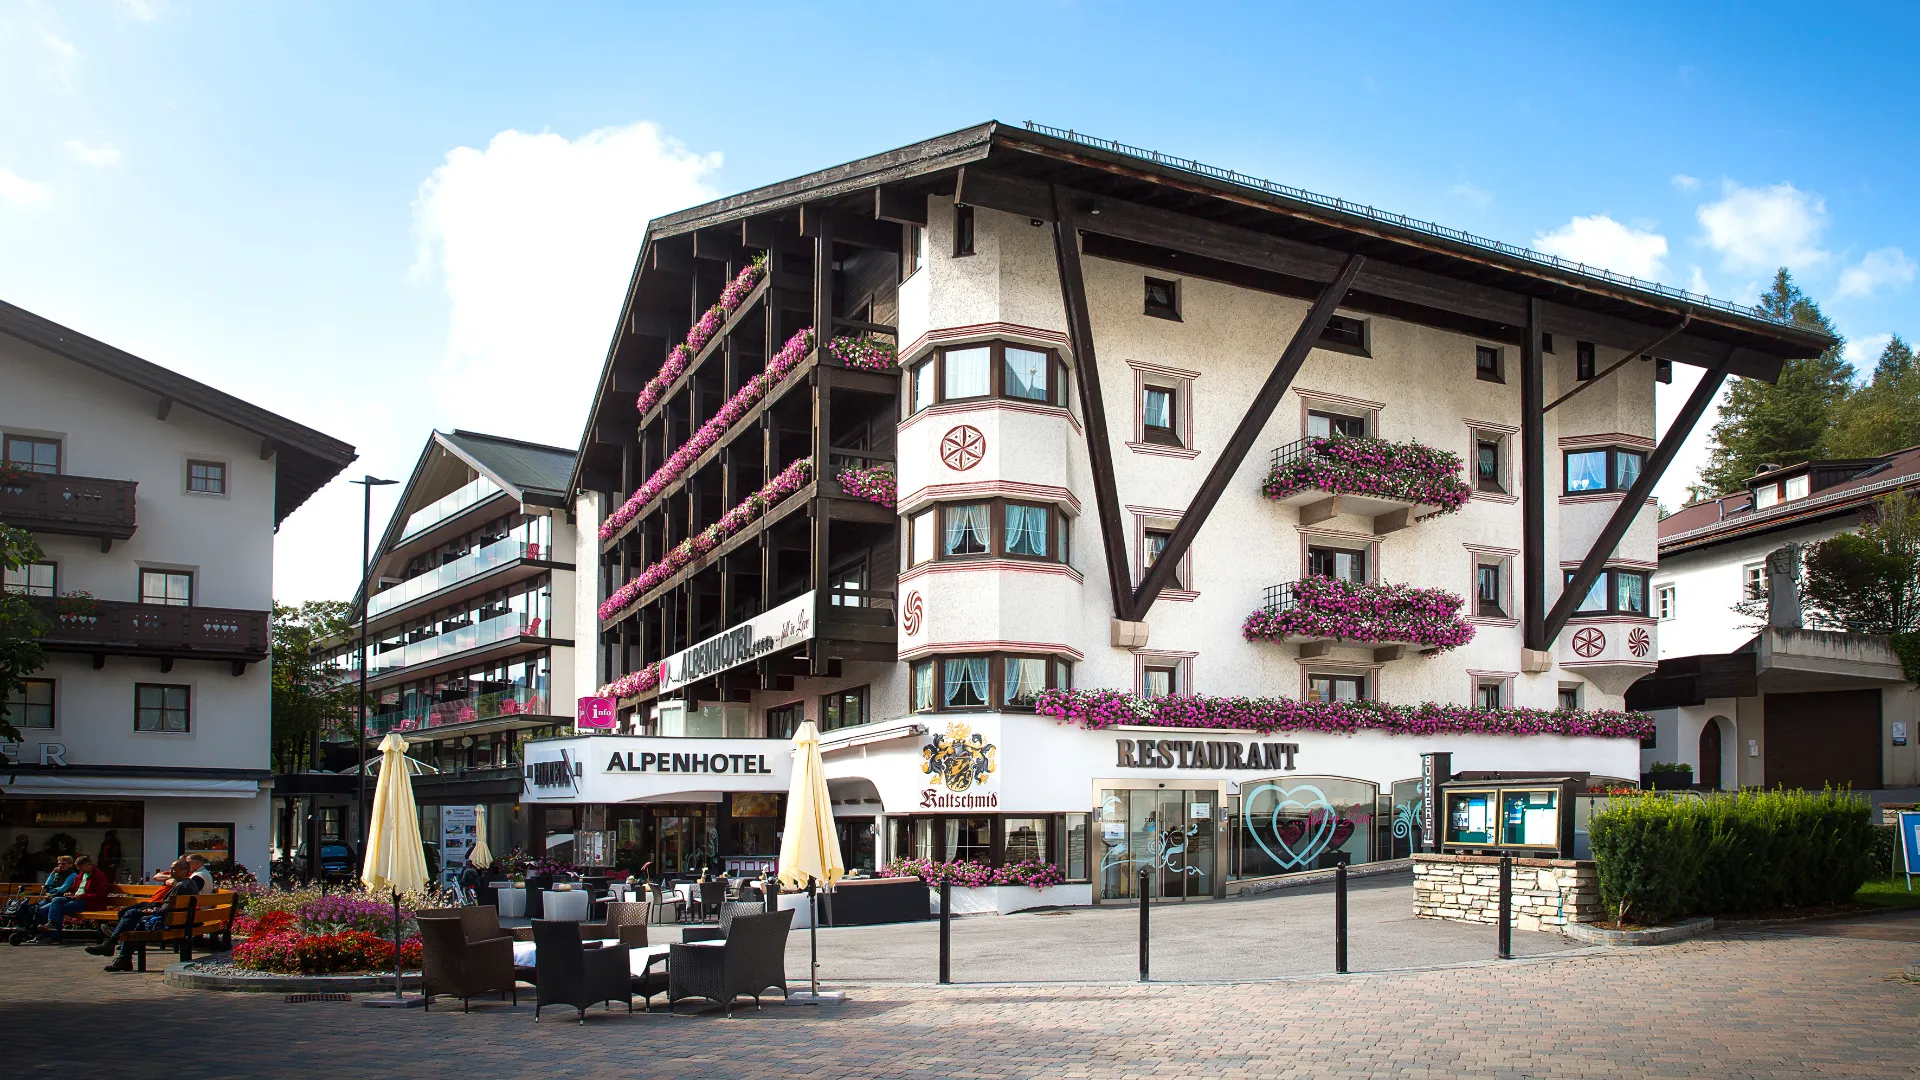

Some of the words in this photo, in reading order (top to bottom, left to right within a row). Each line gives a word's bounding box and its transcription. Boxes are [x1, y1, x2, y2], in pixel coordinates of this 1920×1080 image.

[680, 624, 754, 682] ALPENHOTEL
[592, 704, 611, 719] info
[606, 751, 771, 774] ALPENHOTEL
[1116, 739, 1299, 770] RESTAURANT
[920, 788, 997, 810] Kaltschmid
[1342, 803, 1371, 831] Love
